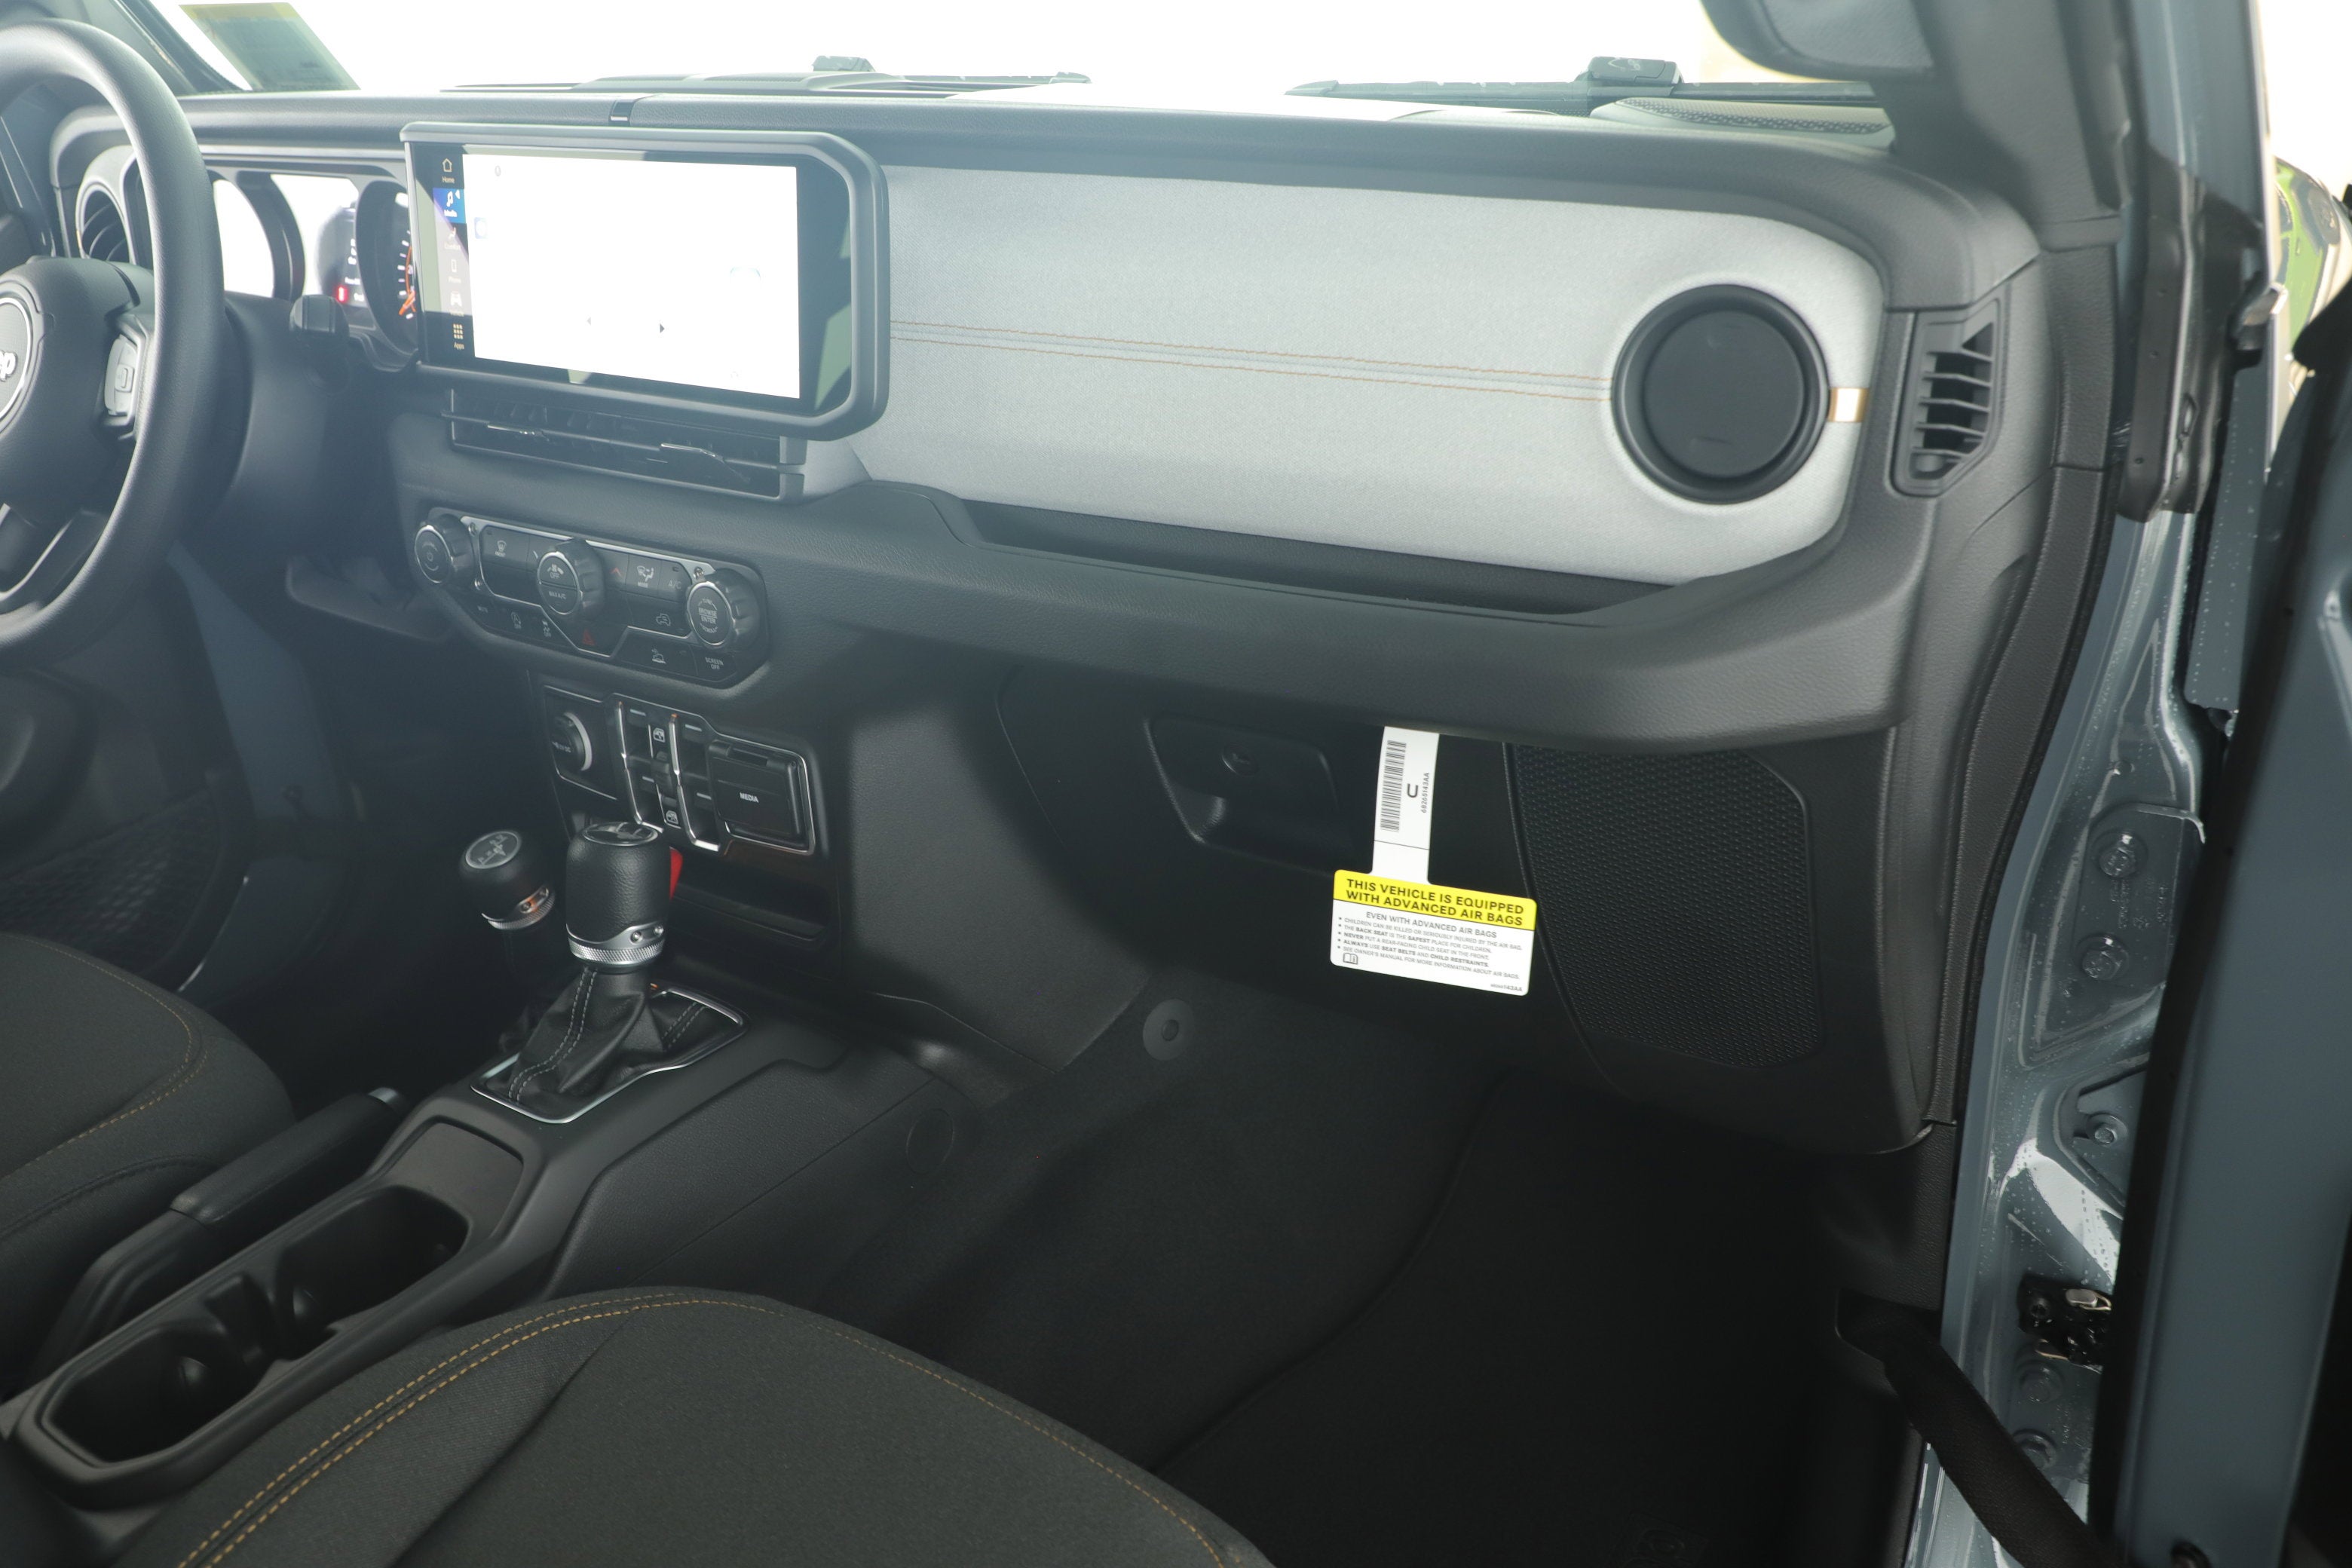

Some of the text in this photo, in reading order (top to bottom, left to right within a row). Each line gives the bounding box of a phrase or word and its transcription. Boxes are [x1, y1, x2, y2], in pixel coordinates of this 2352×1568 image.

[454, 341, 465, 351] Apps
[668, 580, 682, 590] A/C
[698, 608, 717, 617] BROWSE
[701, 616, 716, 624] ENTER
[705, 657, 724, 666] SCREEN
[1407, 783, 1419, 798] U
[740, 792, 759, 804] MEDIA
[1347, 879, 1524, 914] THIS VEHICLE IS EQUIPPED
[1346, 890, 1523, 926] WITH ADVANCED AIR BAGS
[1366, 911, 1387, 921] EVEN
[1389, 915, 1410, 924] WITH
[1412, 919, 1456, 932] ADVANCED
[1475, 929, 1497, 938] BAGS
[1344, 917, 1371, 927] CHILDREN
[1423, 930, 1453, 940] SERIOUSLY
[1454, 935, 1477, 944] INJURED
[1355, 926, 1372, 934] BACK
[1343, 939, 1368, 948] ALWAYS
[1382, 939, 1417, 948] REAR-FACING
[1354, 948, 1379, 957] OWNER'S
[1380, 953, 1402, 961] MANUAL
[1434, 962, 1472, 972] INFORMATION
